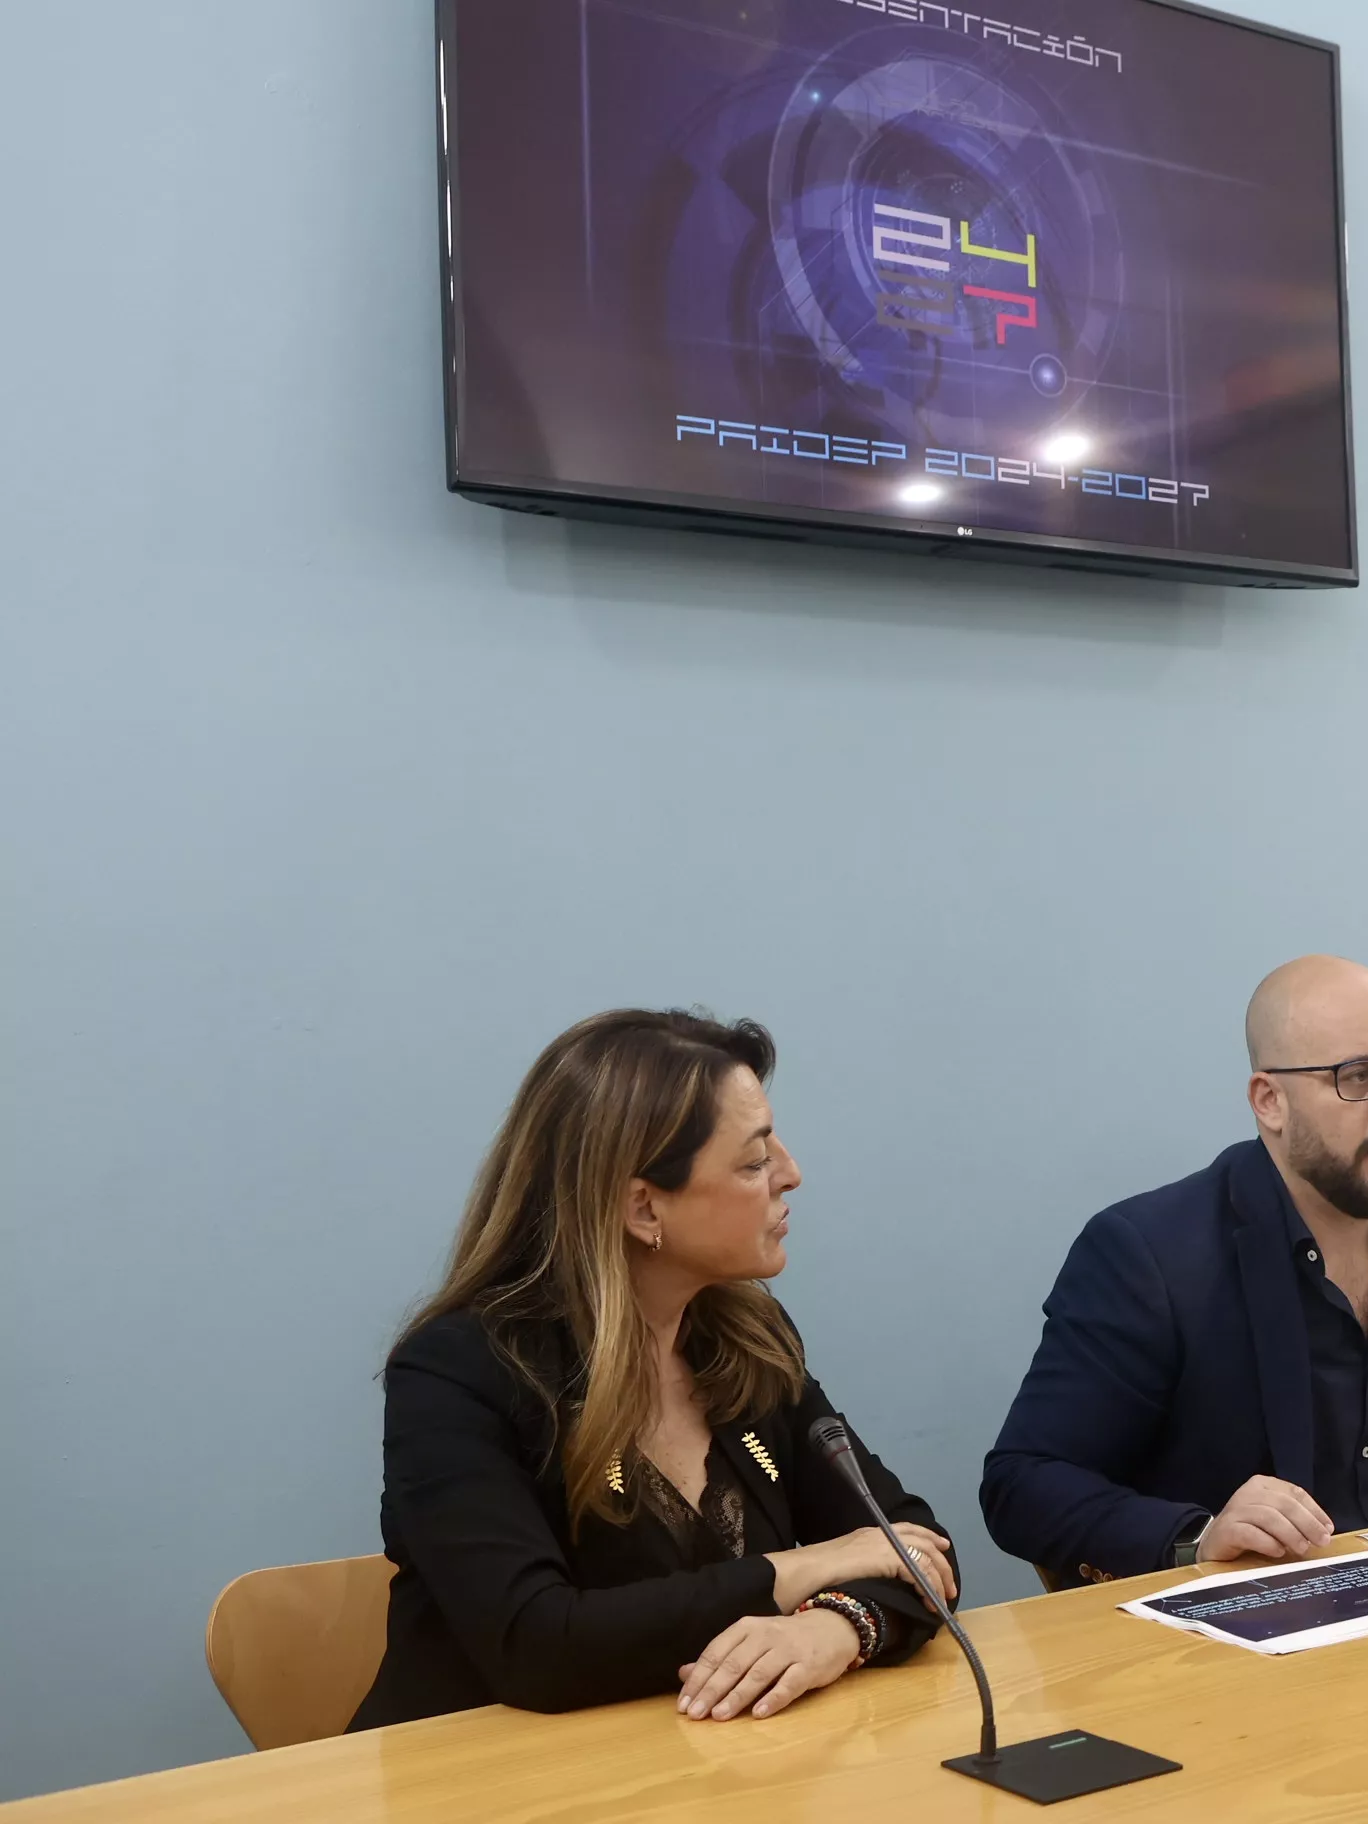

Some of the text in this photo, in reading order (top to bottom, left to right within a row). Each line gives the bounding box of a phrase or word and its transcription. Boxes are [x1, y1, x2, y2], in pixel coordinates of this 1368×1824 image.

[873, 203, 1037, 288] 24
[676, 414, 1209, 507] PRIDEP 2024-2027
